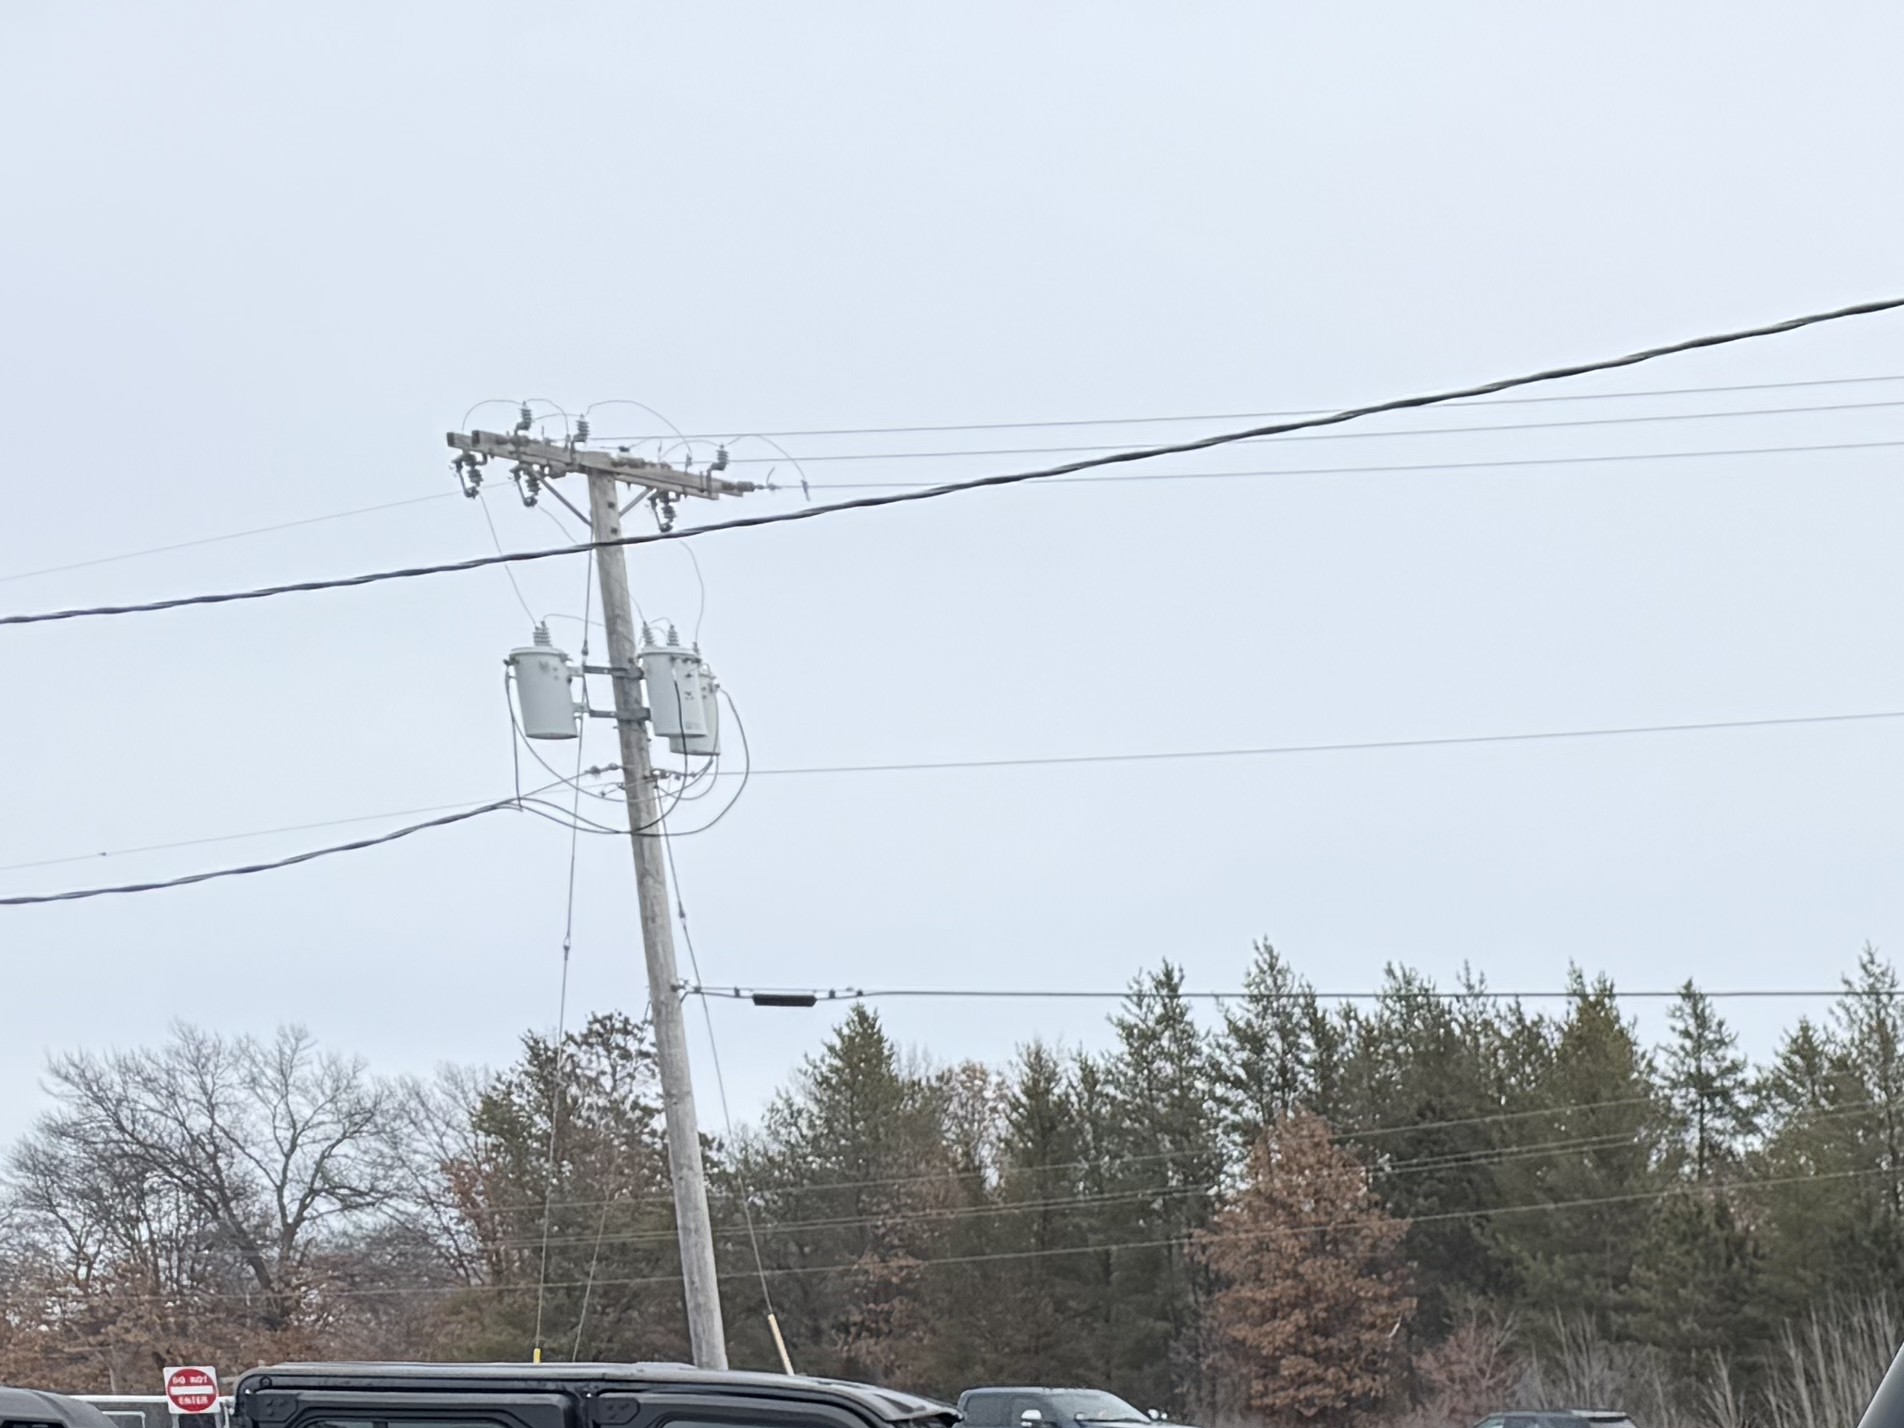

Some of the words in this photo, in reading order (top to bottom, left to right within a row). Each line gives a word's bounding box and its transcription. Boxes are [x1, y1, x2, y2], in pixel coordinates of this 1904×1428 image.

[172, 1375, 186, 1384] DO
[190, 1375, 208, 1383] NOT
[178, 1396, 209, 1405] ENTER
